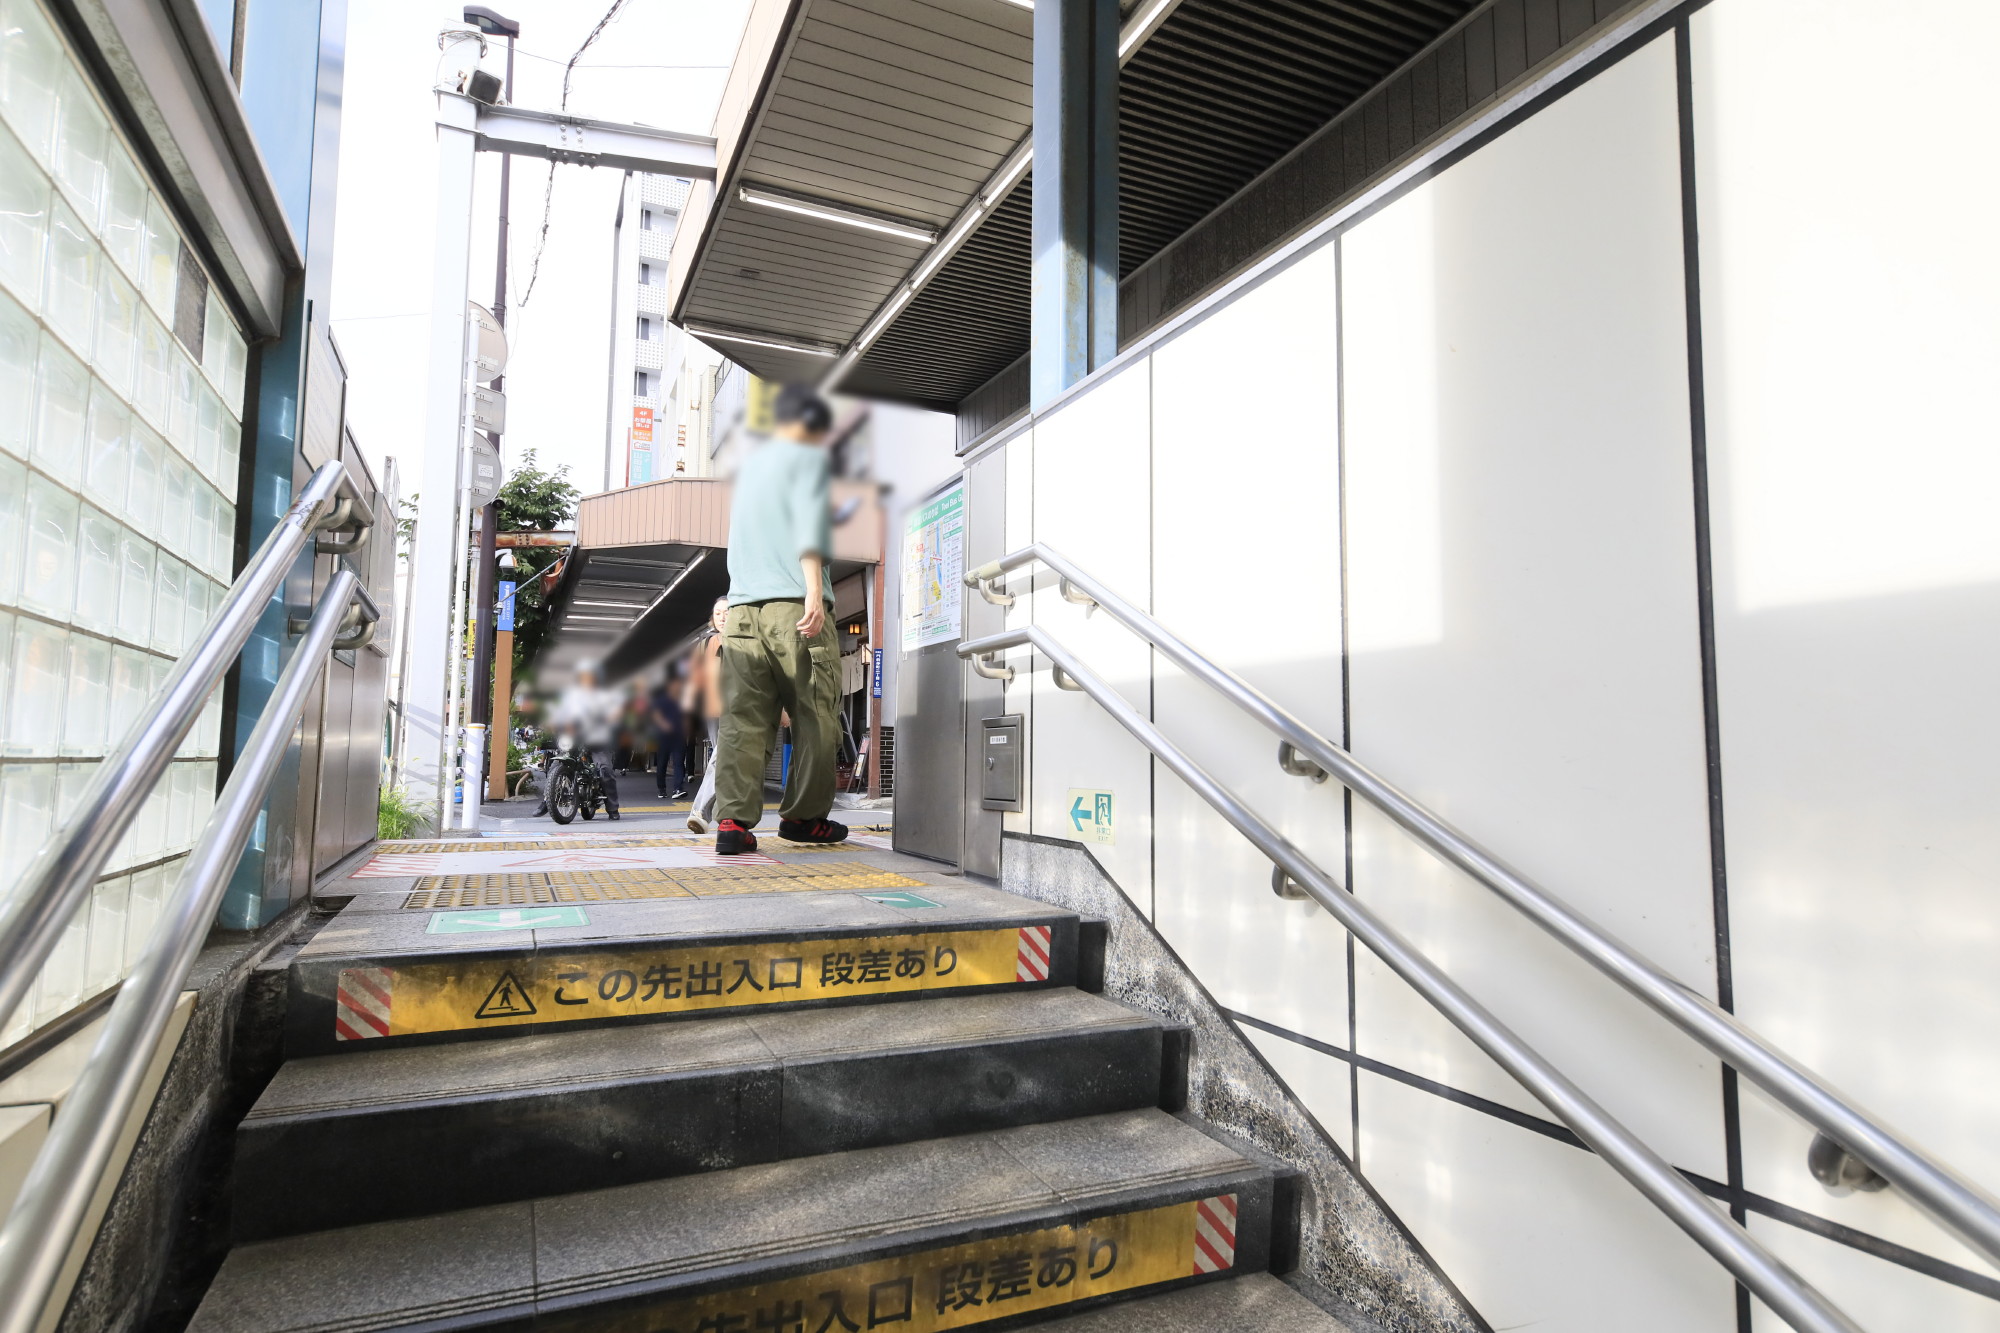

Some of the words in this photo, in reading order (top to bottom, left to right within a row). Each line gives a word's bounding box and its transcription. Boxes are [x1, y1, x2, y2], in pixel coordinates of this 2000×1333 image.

[950, 497, 958, 507] Bus
[553, 956, 803, 1005] この先出入口
[819, 945, 958, 988] 段差あり
[650, 1276, 915, 1333] 出入口
[935, 1236, 1119, 1315] 段差あり
